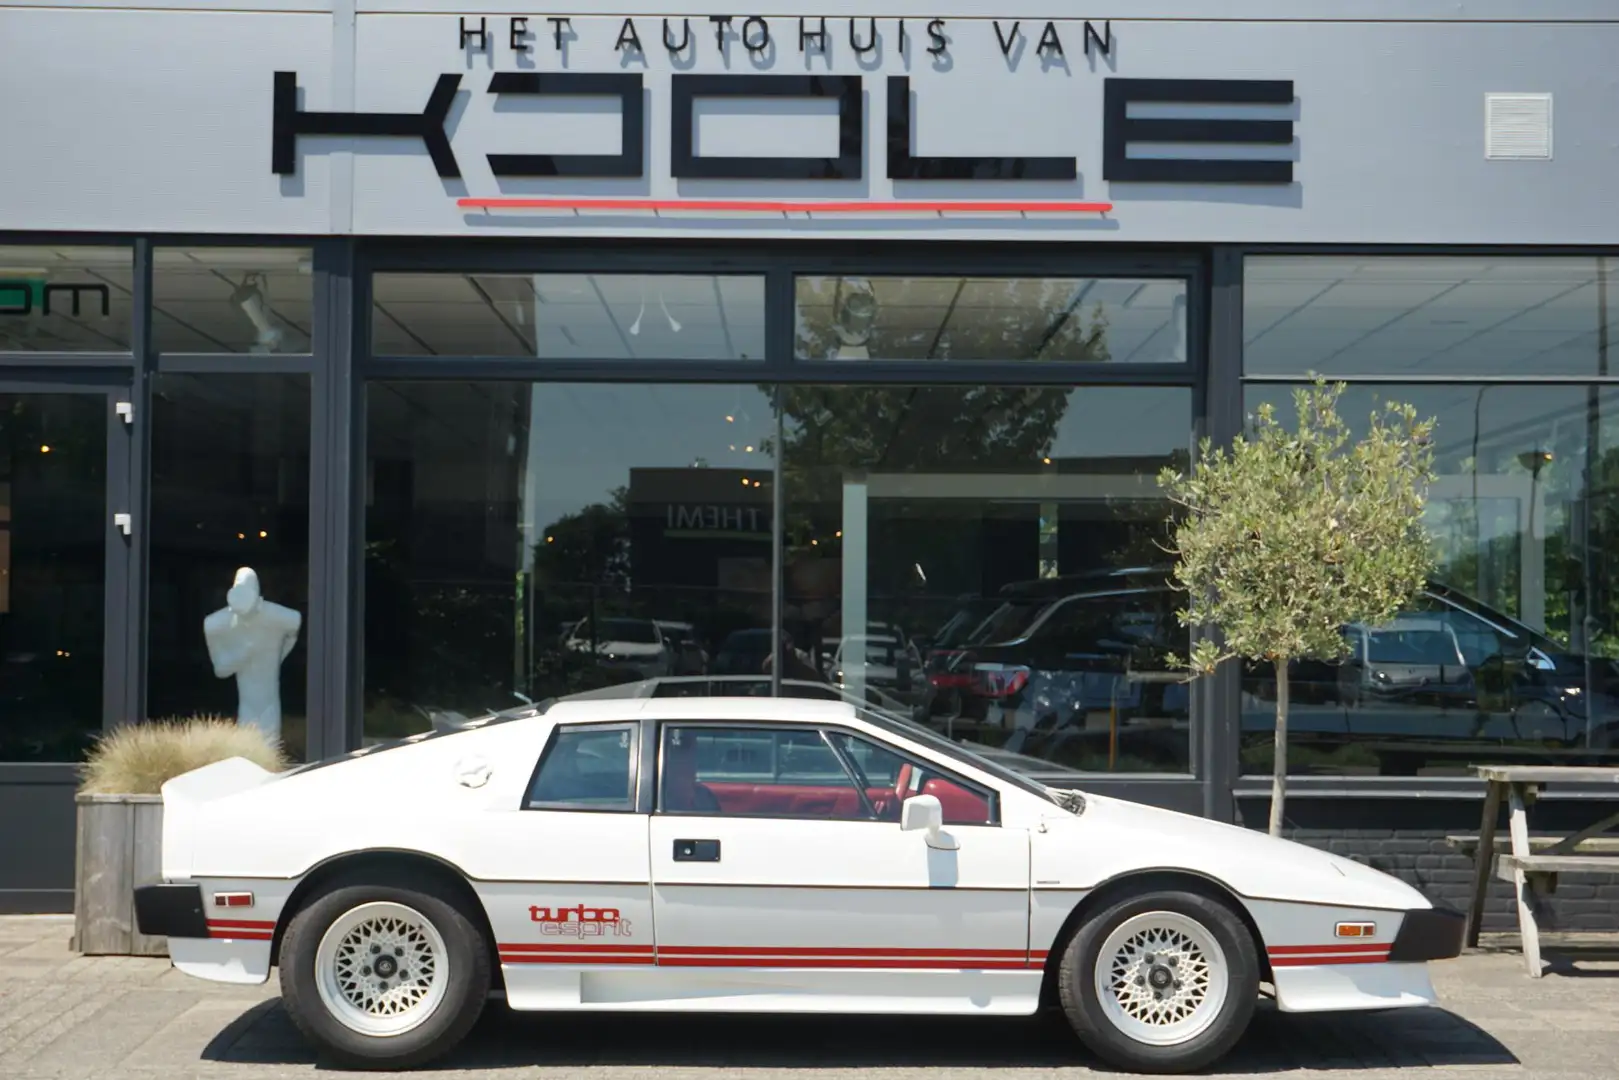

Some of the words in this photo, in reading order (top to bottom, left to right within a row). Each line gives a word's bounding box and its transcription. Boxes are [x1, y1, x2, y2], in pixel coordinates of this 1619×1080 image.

[459, 16, 571, 51] HET
[614, 16, 947, 54] AUTOHUIS
[992, 19, 1111, 55] VAN
[272, 71, 1294, 184] KOOLE
[528, 903, 620, 922] turbo
[540, 918, 633, 940] esprit
